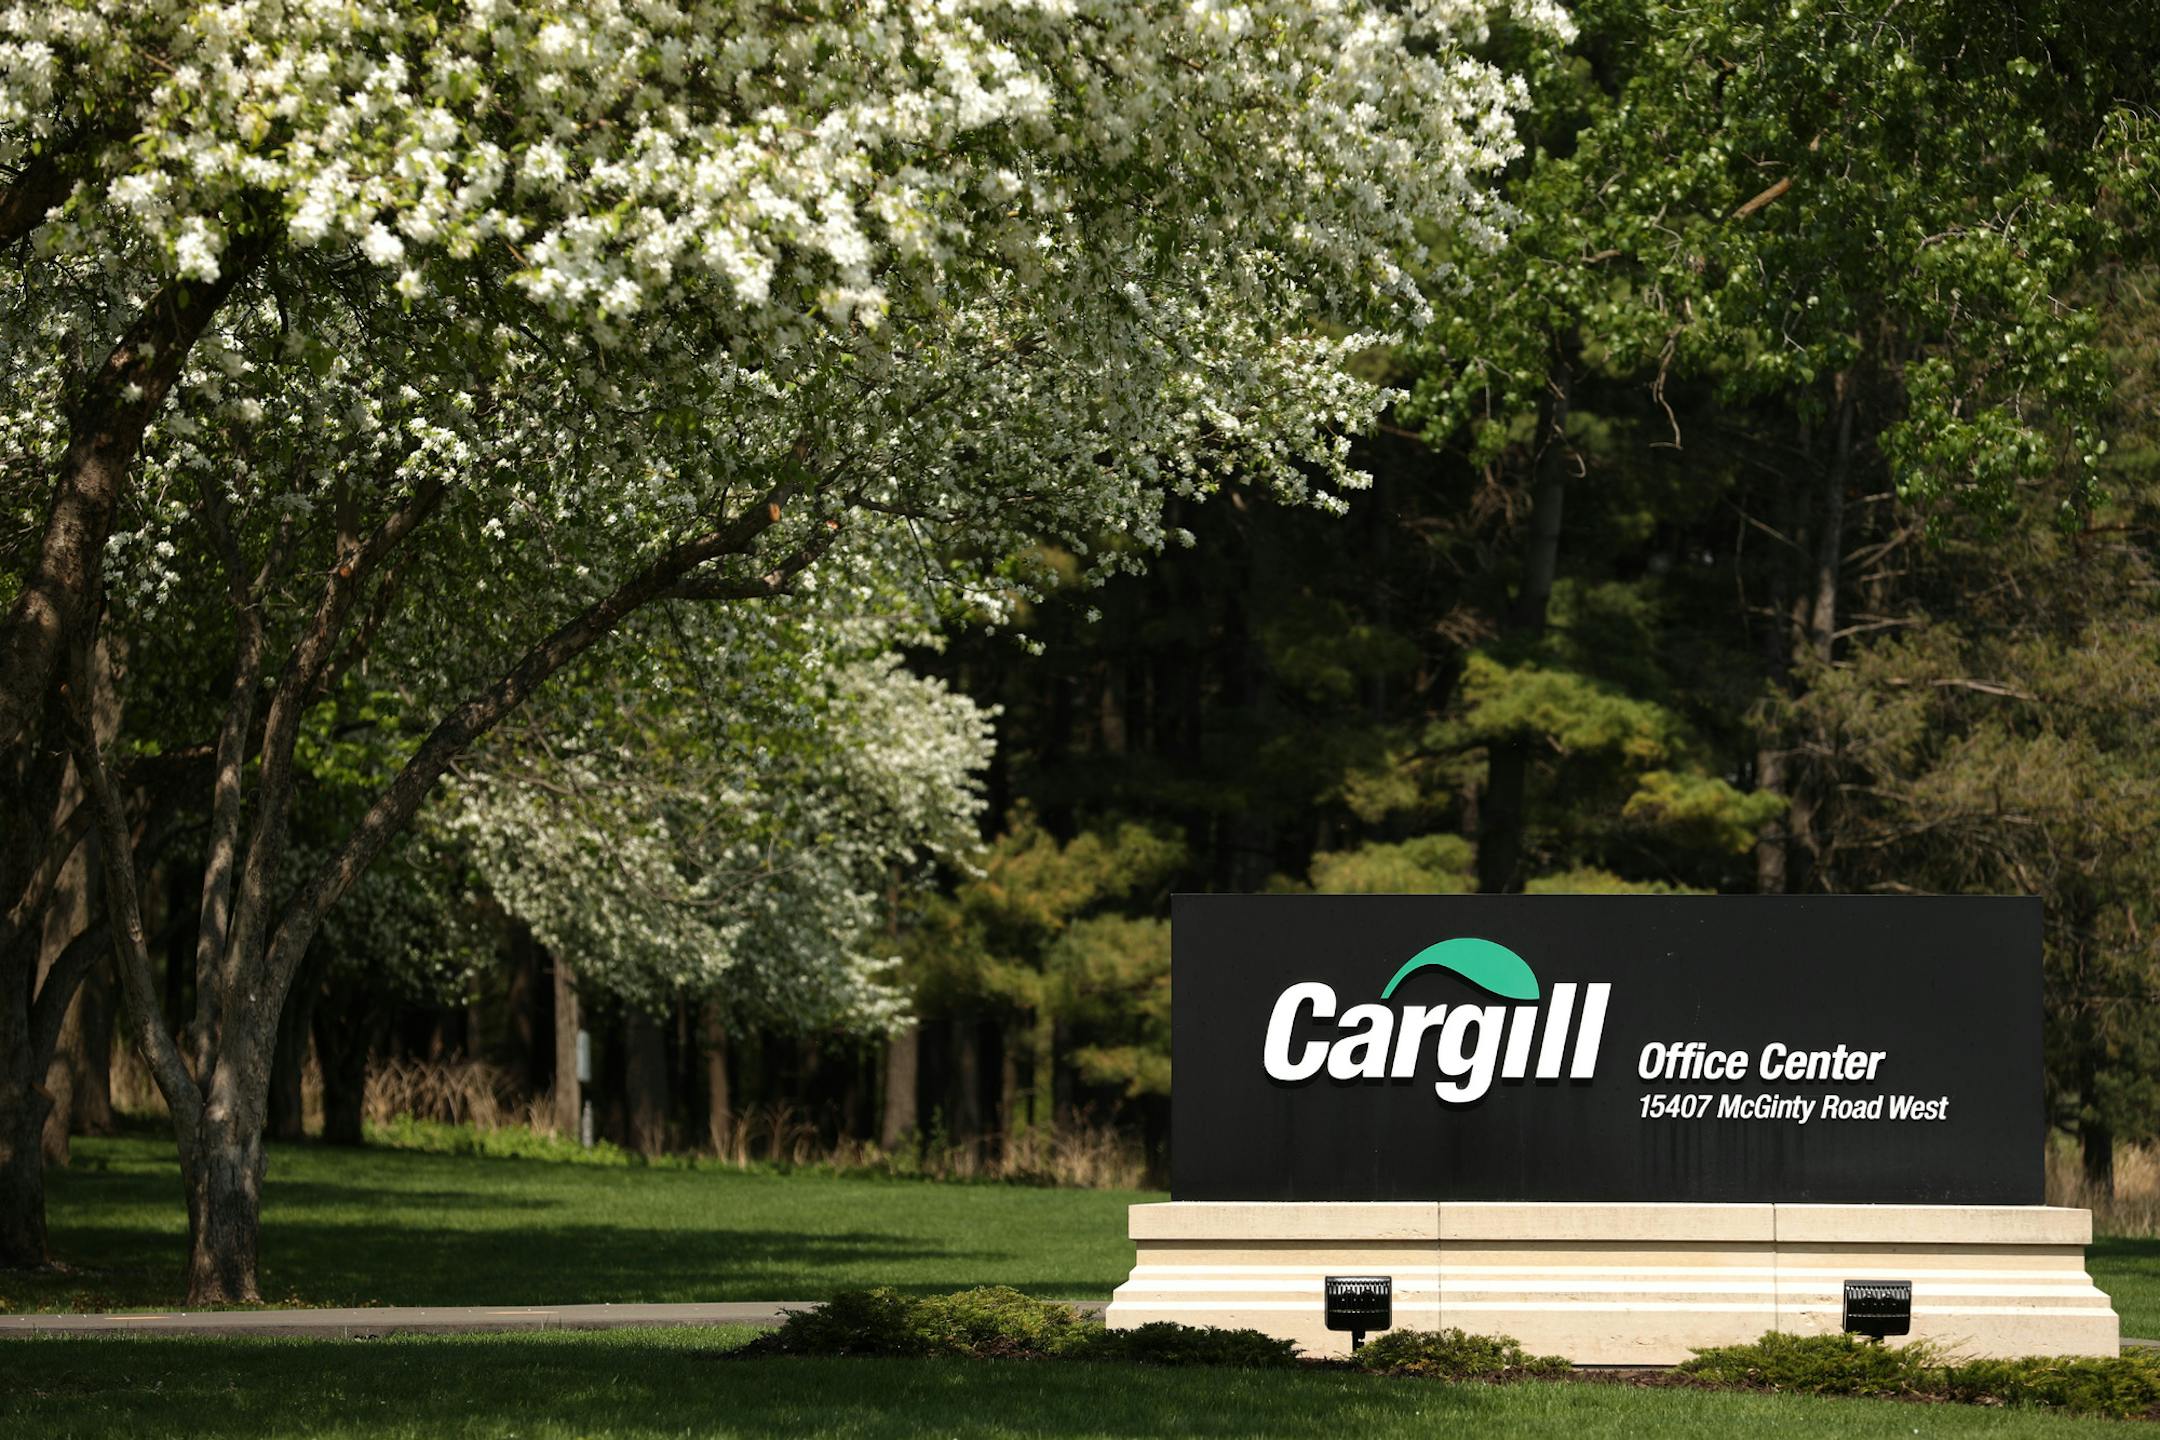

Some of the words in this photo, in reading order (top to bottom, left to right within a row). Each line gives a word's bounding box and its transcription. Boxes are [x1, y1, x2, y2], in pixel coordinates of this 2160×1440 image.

[1263, 981, 1612, 1104] Cargill
[1637, 1041, 1749, 1081] Office
[1759, 1042, 1887, 1081] Center
[1639, 1093, 1714, 1119] 15407
[1716, 1093, 1817, 1125] McGinty
[1820, 1094, 1885, 1120] Road
[1888, 1094, 1950, 1121] West
